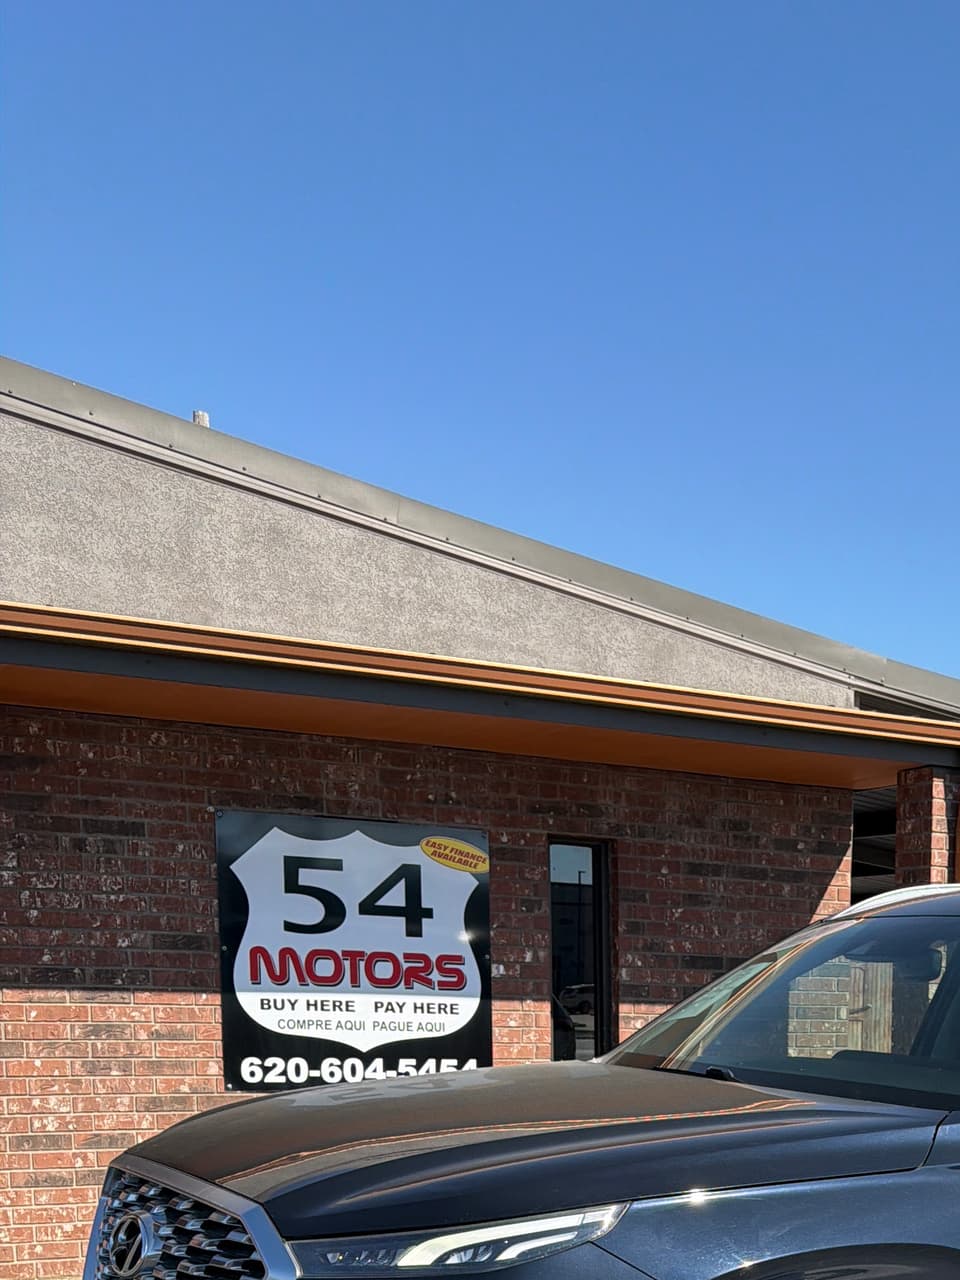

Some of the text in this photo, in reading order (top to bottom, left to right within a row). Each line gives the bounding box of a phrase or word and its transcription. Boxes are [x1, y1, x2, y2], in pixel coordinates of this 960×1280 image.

[424, 839, 487, 864] EASY FINANCE
[430, 849, 480, 869] AVAILABLE
[283, 855, 434, 938] 54
[249, 946, 467, 991] MOTORS
[259, 998, 460, 1015] BUY HERE PAY HERE
[277, 1019, 446, 1033] COMPRE AQUI PAGUE AQUI
